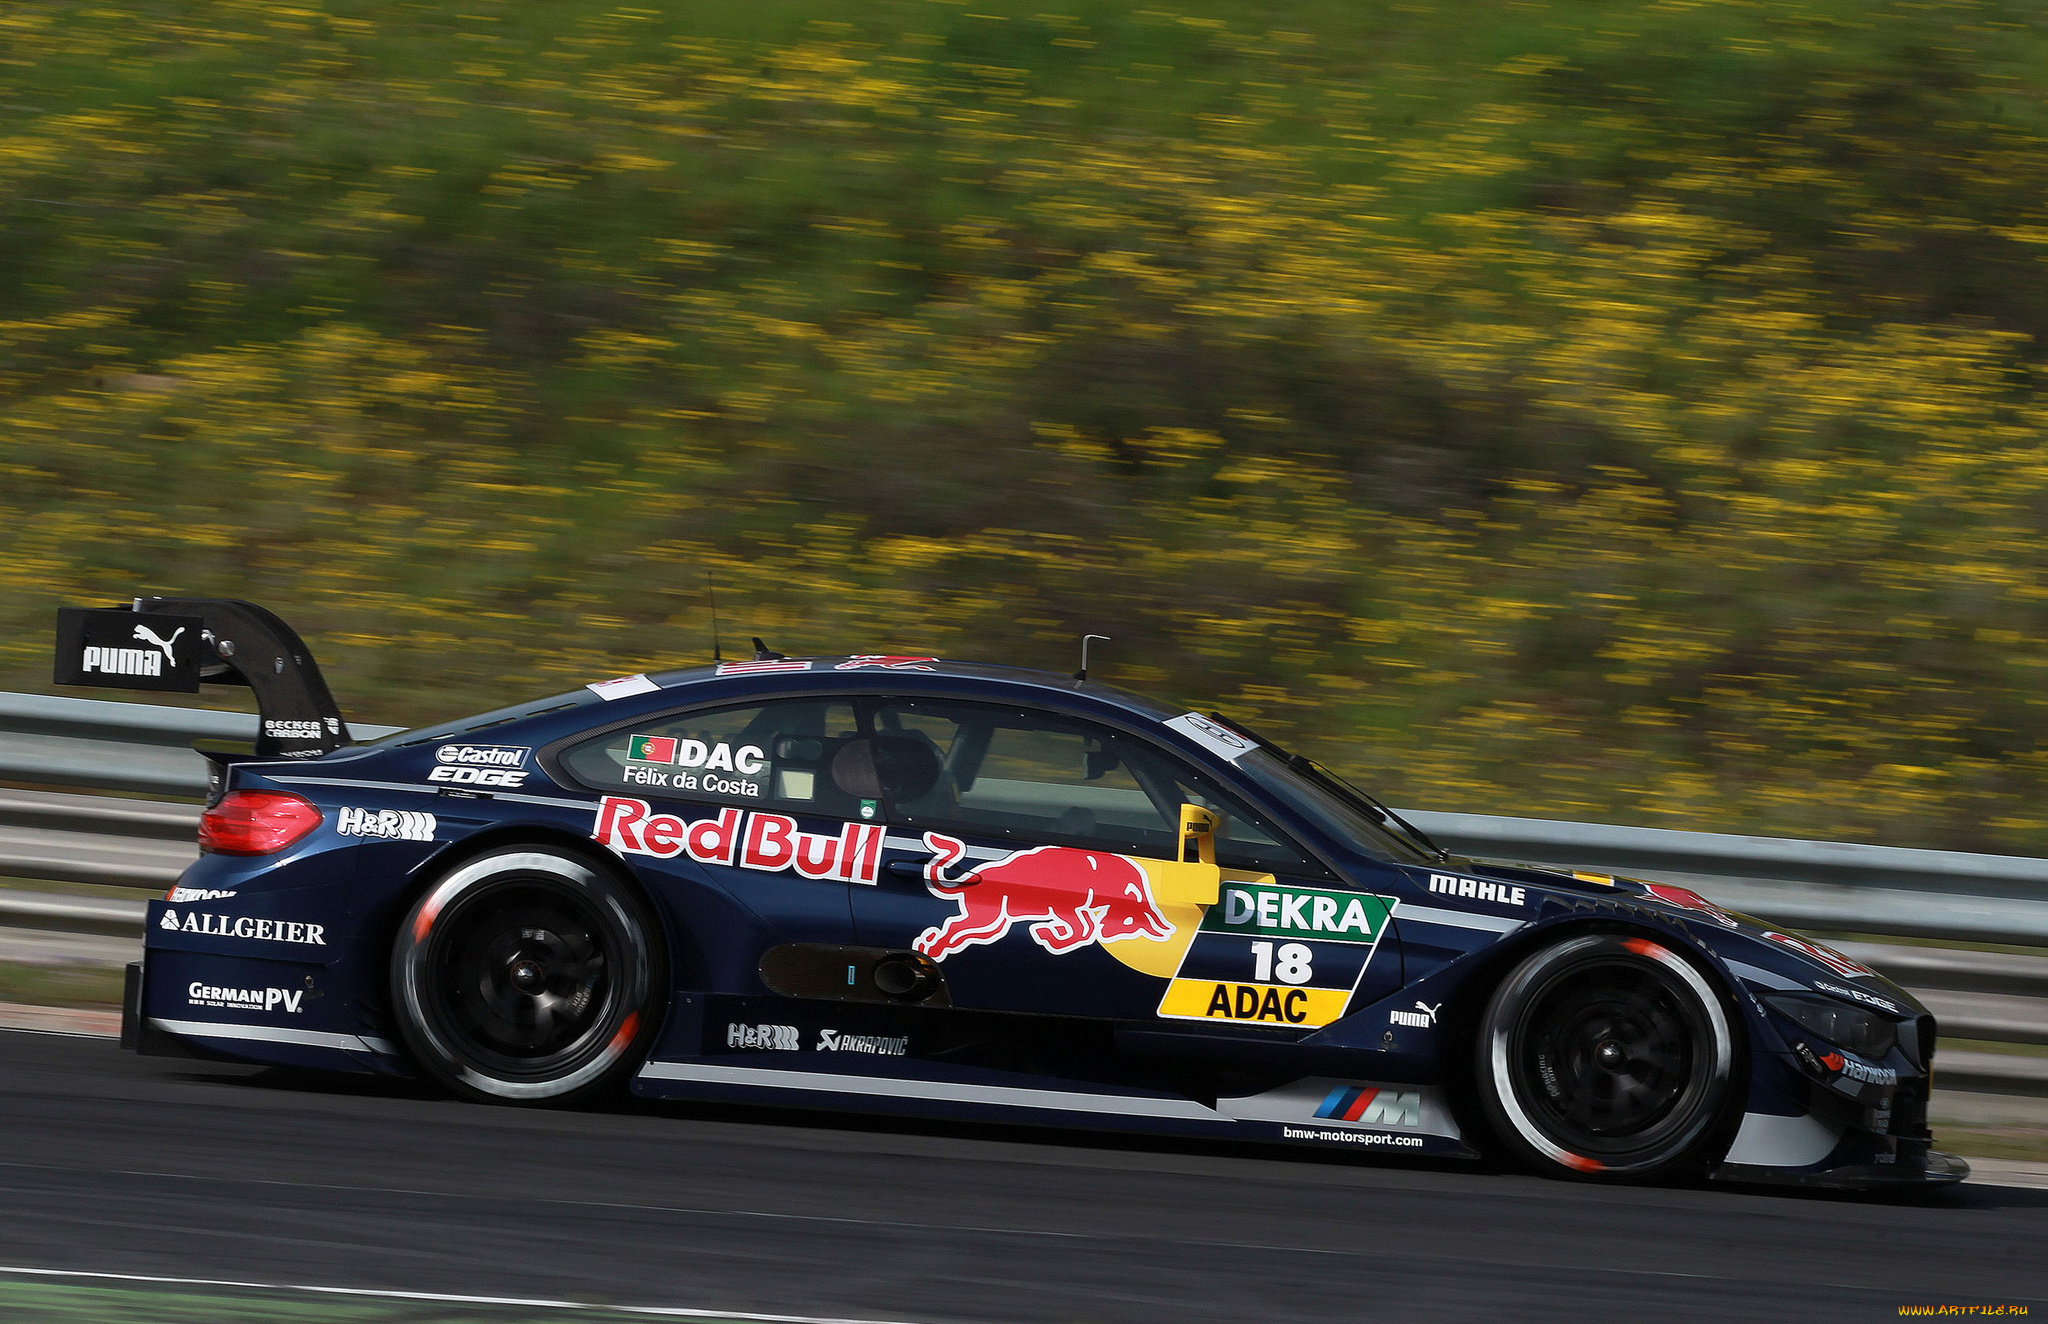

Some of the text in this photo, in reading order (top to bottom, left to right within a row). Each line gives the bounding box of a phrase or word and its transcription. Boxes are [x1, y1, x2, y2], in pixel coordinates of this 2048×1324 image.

[83, 646, 162, 677] PUMA
[264, 720, 321, 730] BECKER
[264, 729, 321, 739] CARBON
[457, 746, 524, 766] Castrol
[678, 738, 765, 775] DAC
[427, 765, 530, 788] EDGE
[622, 765, 759, 797] Félix da Costa
[592, 796, 888, 887] Red Bull
[1428, 873, 1526, 906] MAHLE
[1224, 888, 1373, 936] DEKRA
[180, 912, 327, 947] ALLGEIER
[1250, 940, 1313, 985] 18
[1206, 984, 1309, 1024] ADAC
[1389, 1010, 1430, 1029] PUMA
[1283, 1126, 1424, 1147] bmw-motorsport.com
